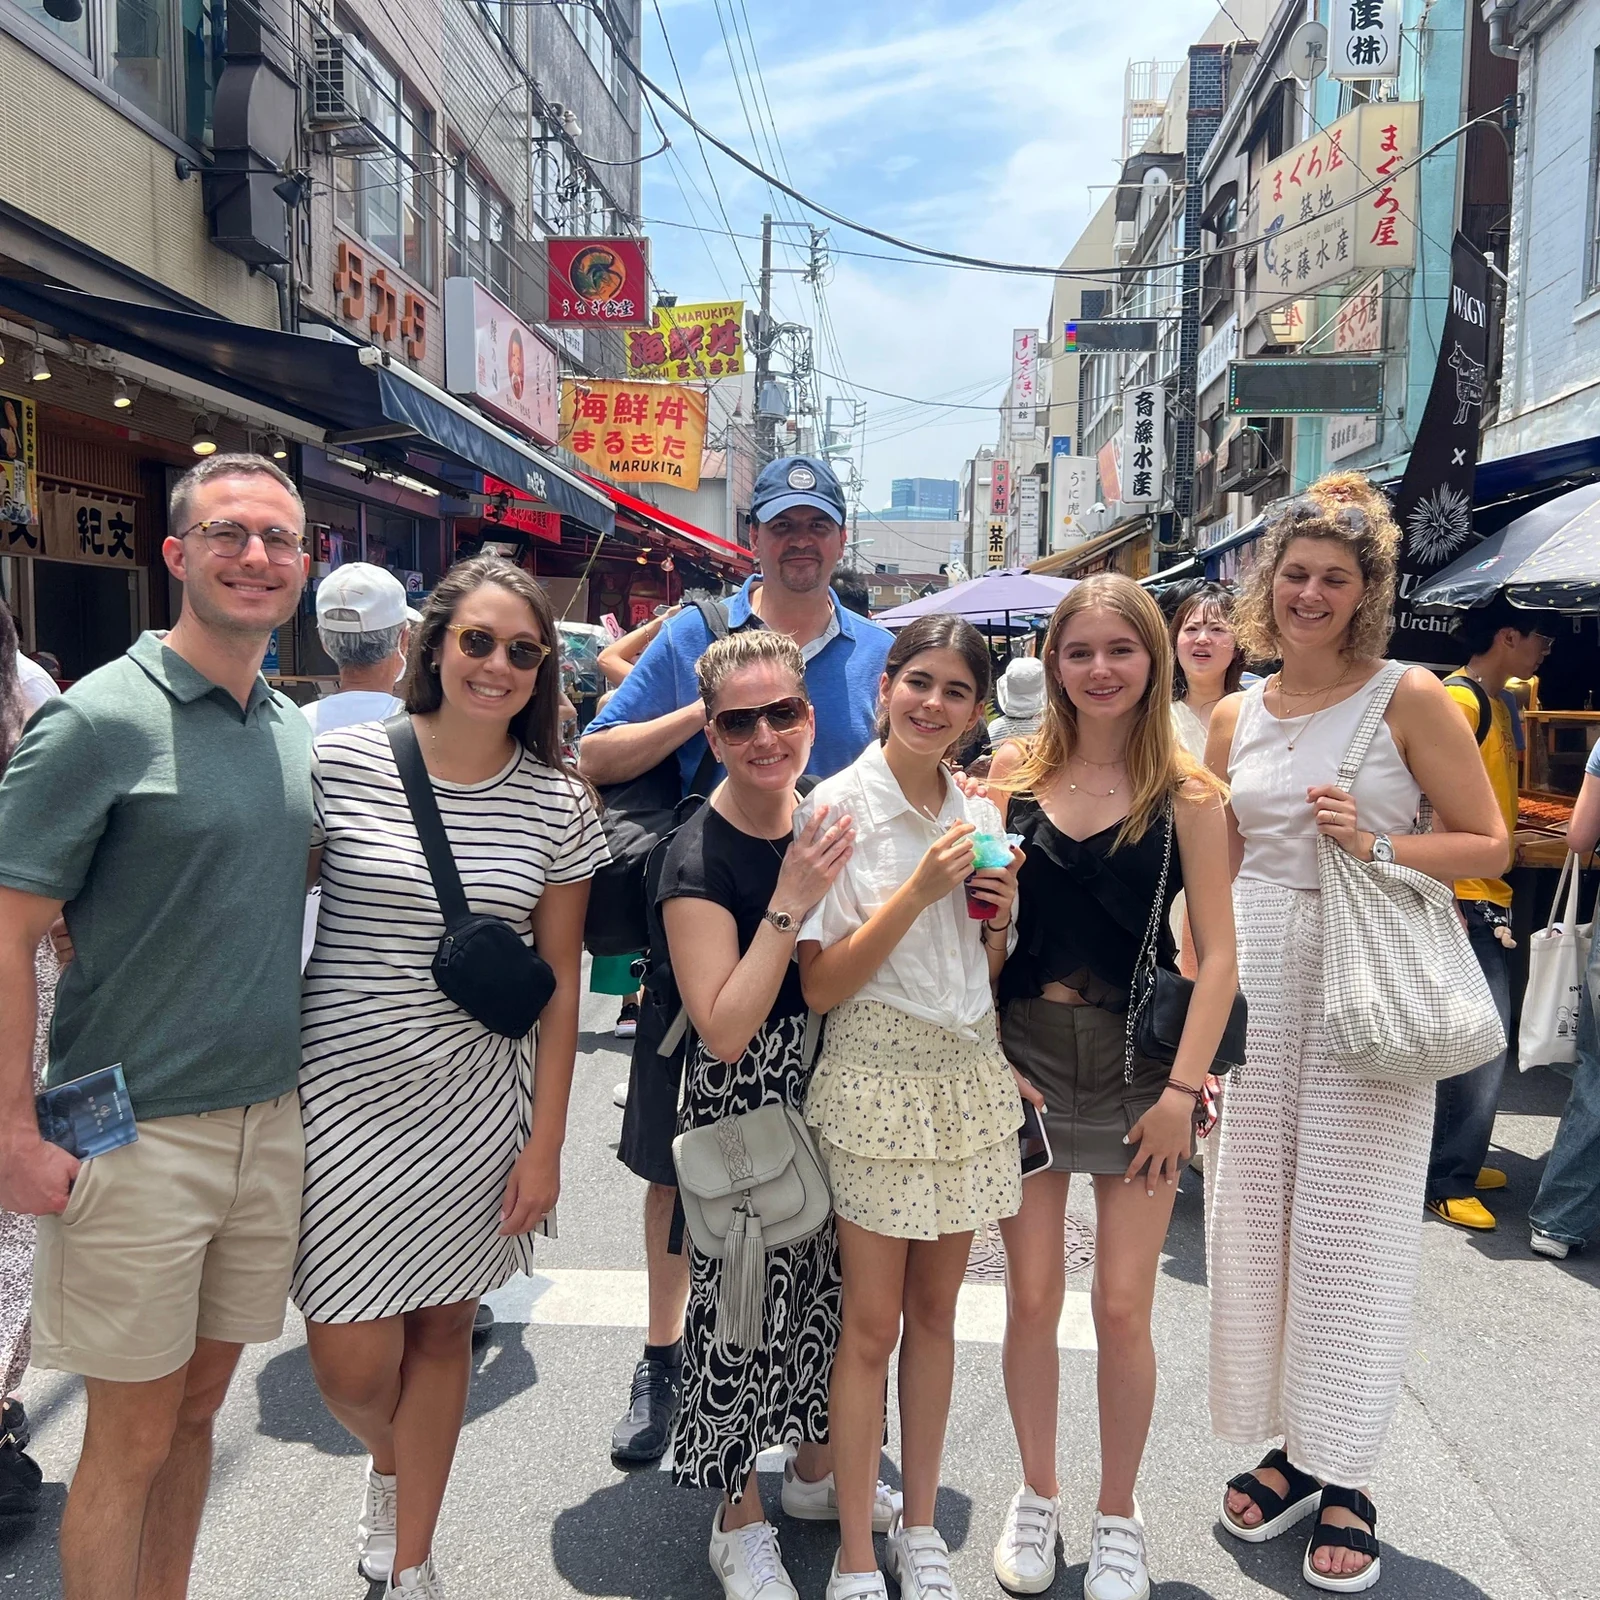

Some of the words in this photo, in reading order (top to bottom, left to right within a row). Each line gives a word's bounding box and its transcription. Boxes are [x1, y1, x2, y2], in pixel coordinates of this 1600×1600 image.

[1272, 129, 1344, 203] まぐろ屋
[1370, 124, 1404, 247] まぐろ屋
[1299, 183, 1335, 227] 築地
[333, 239, 427, 361] タカタ
[561, 298, 636, 318] うなぎ食堂
[677, 306, 736, 324] MARUKITA
[628, 318, 742, 369] 海鮮丼
[675, 357, 741, 379] まるきた
[571, 391, 689, 430] 海鮮丼
[571, 429, 687, 460] まるきた
[609, 460, 683, 478] MARUKITA
[1067, 471, 1080, 516] うに虎
[76, 505, 135, 560] 紀文
[988, 524, 1004, 553] 茶
